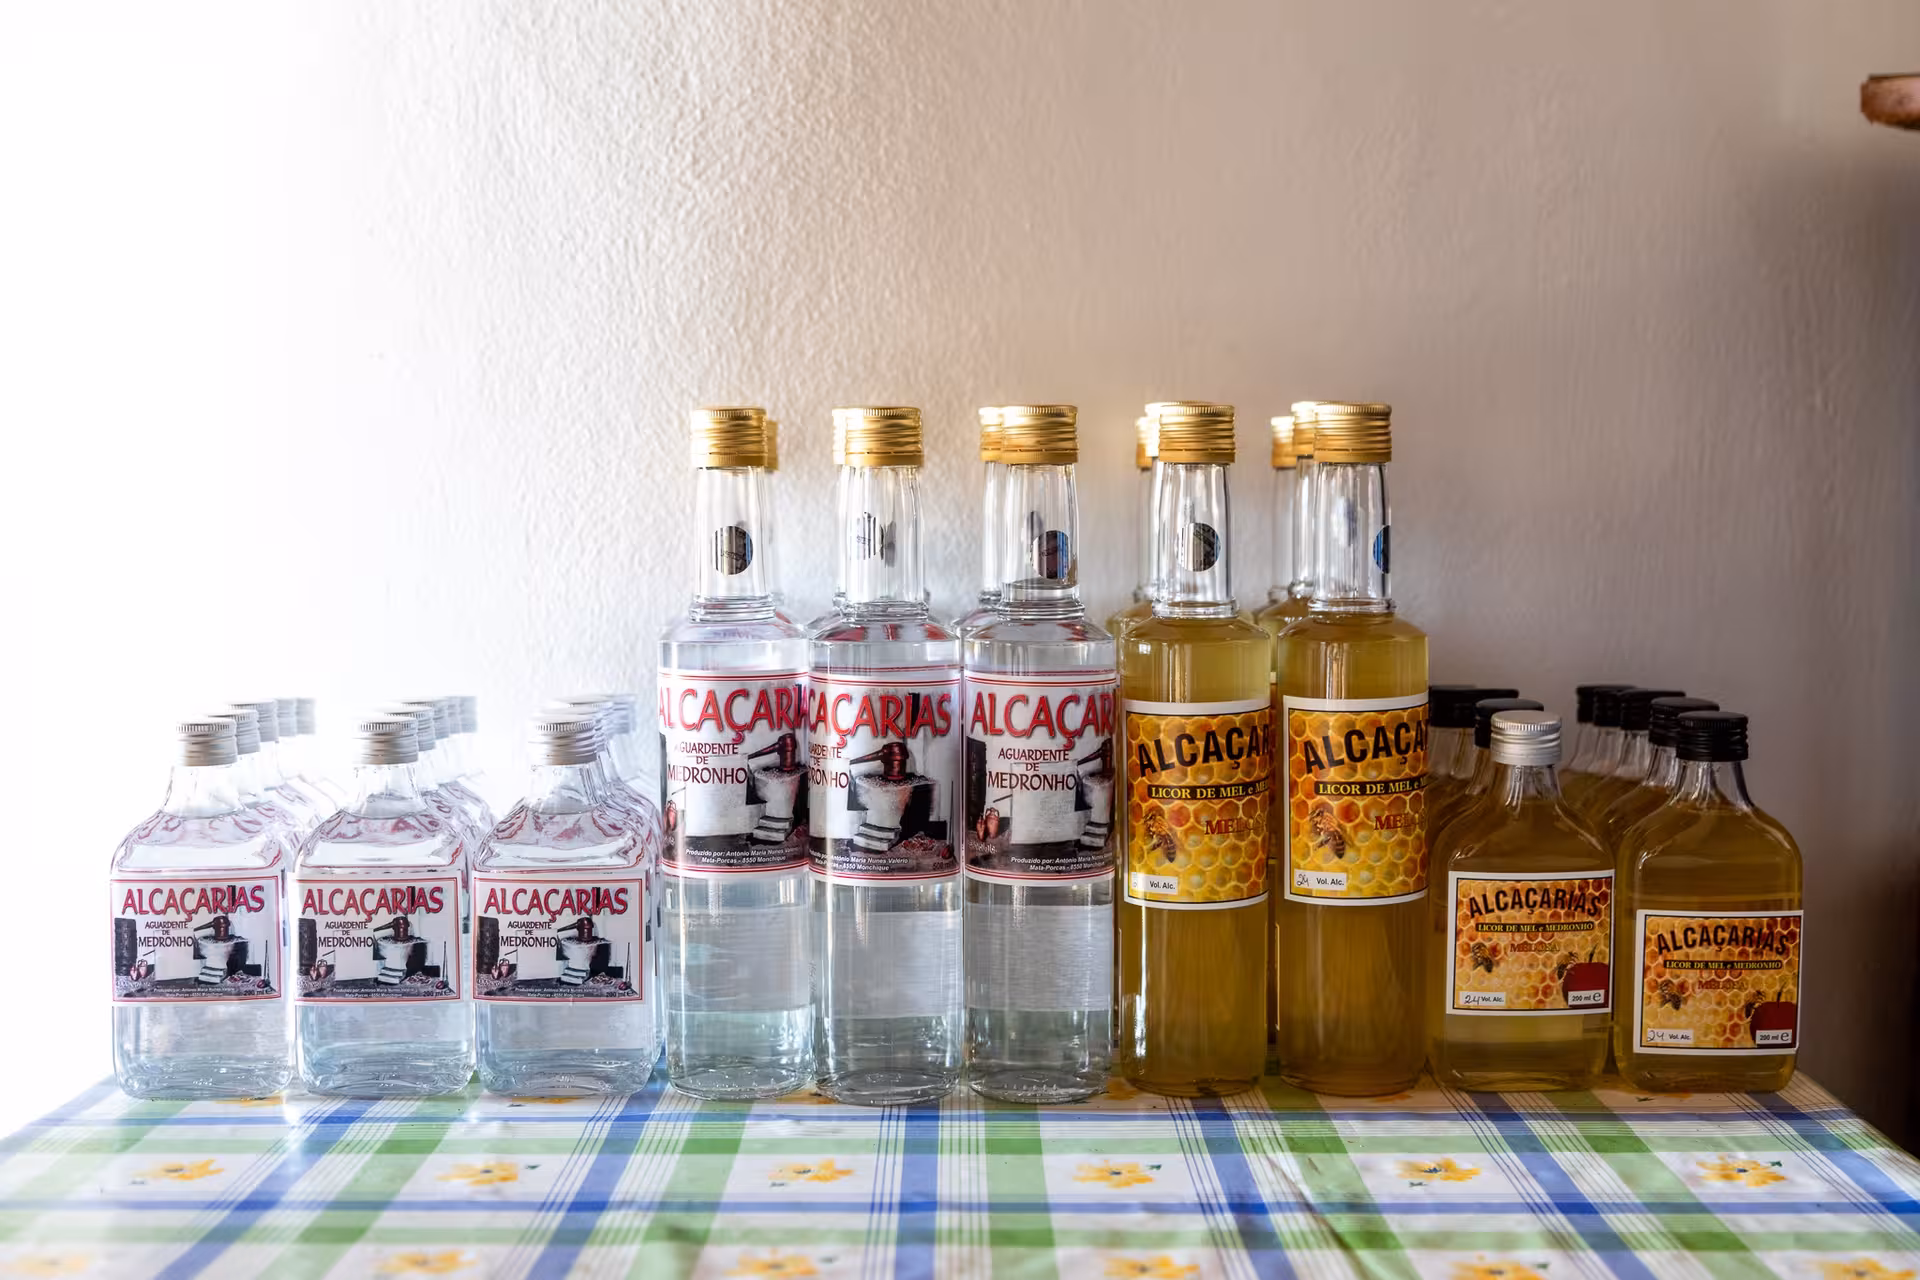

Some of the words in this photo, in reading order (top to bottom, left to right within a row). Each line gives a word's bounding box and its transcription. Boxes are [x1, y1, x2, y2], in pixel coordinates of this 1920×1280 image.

[696, 756, 709, 765] DE
[998, 748, 1069, 761] AGUARDENTE
[1025, 762, 1040, 772] DE
[667, 764, 748, 785] MEDRONHO
[987, 771, 1077, 791] MEDRONHO
[1318, 783, 1361, 795] LICOR
[1365, 783, 1385, 795] DE
[1388, 779, 1413, 793] MEL
[1414, 781, 1420, 789] e
[1151, 786, 1191, 799] LICOR
[1196, 787, 1216, 799] DE
[1219, 785, 1246, 798] MEL
[1247, 786, 1254, 794] e
[1149, 880, 1162, 889] Vol.
[1162, 881, 1176, 890] Alc.
[1316, 877, 1330, 886] Vol.
[1330, 878, 1345, 886] Alc.
[121, 884, 266, 922] ALCAÇARIAS
[301, 886, 445, 922] ALCAÇARIAS
[483, 887, 629, 923] ALCAÇARIAS
[1468, 887, 1602, 919] ALCAÇARIAS
[144, 920, 188, 930] AGUARDENTE
[324, 921, 369, 930] AGUARDENTE
[507, 921, 552, 929] AGUARDENTE
[1478, 923, 1504, 932] LICOR
[1505, 924, 1519, 932] DE
[1520, 924, 1538, 932] MEL
[1545, 922, 1594, 932] MEDRONHO
[138, 936, 194, 948] MEDRONHO
[317, 936, 375, 948] MEDRONHO
[500, 935, 558, 948] MEDRONHO
[1656, 924, 1790, 956] ALCAÇARIAS
[1665, 960, 1692, 969] LICOR
[1693, 961, 1706, 969] DE
[1707, 961, 1725, 969] MEL
[1733, 960, 1782, 969] MEDRONHO
[1571, 994, 1583, 1002] 200
